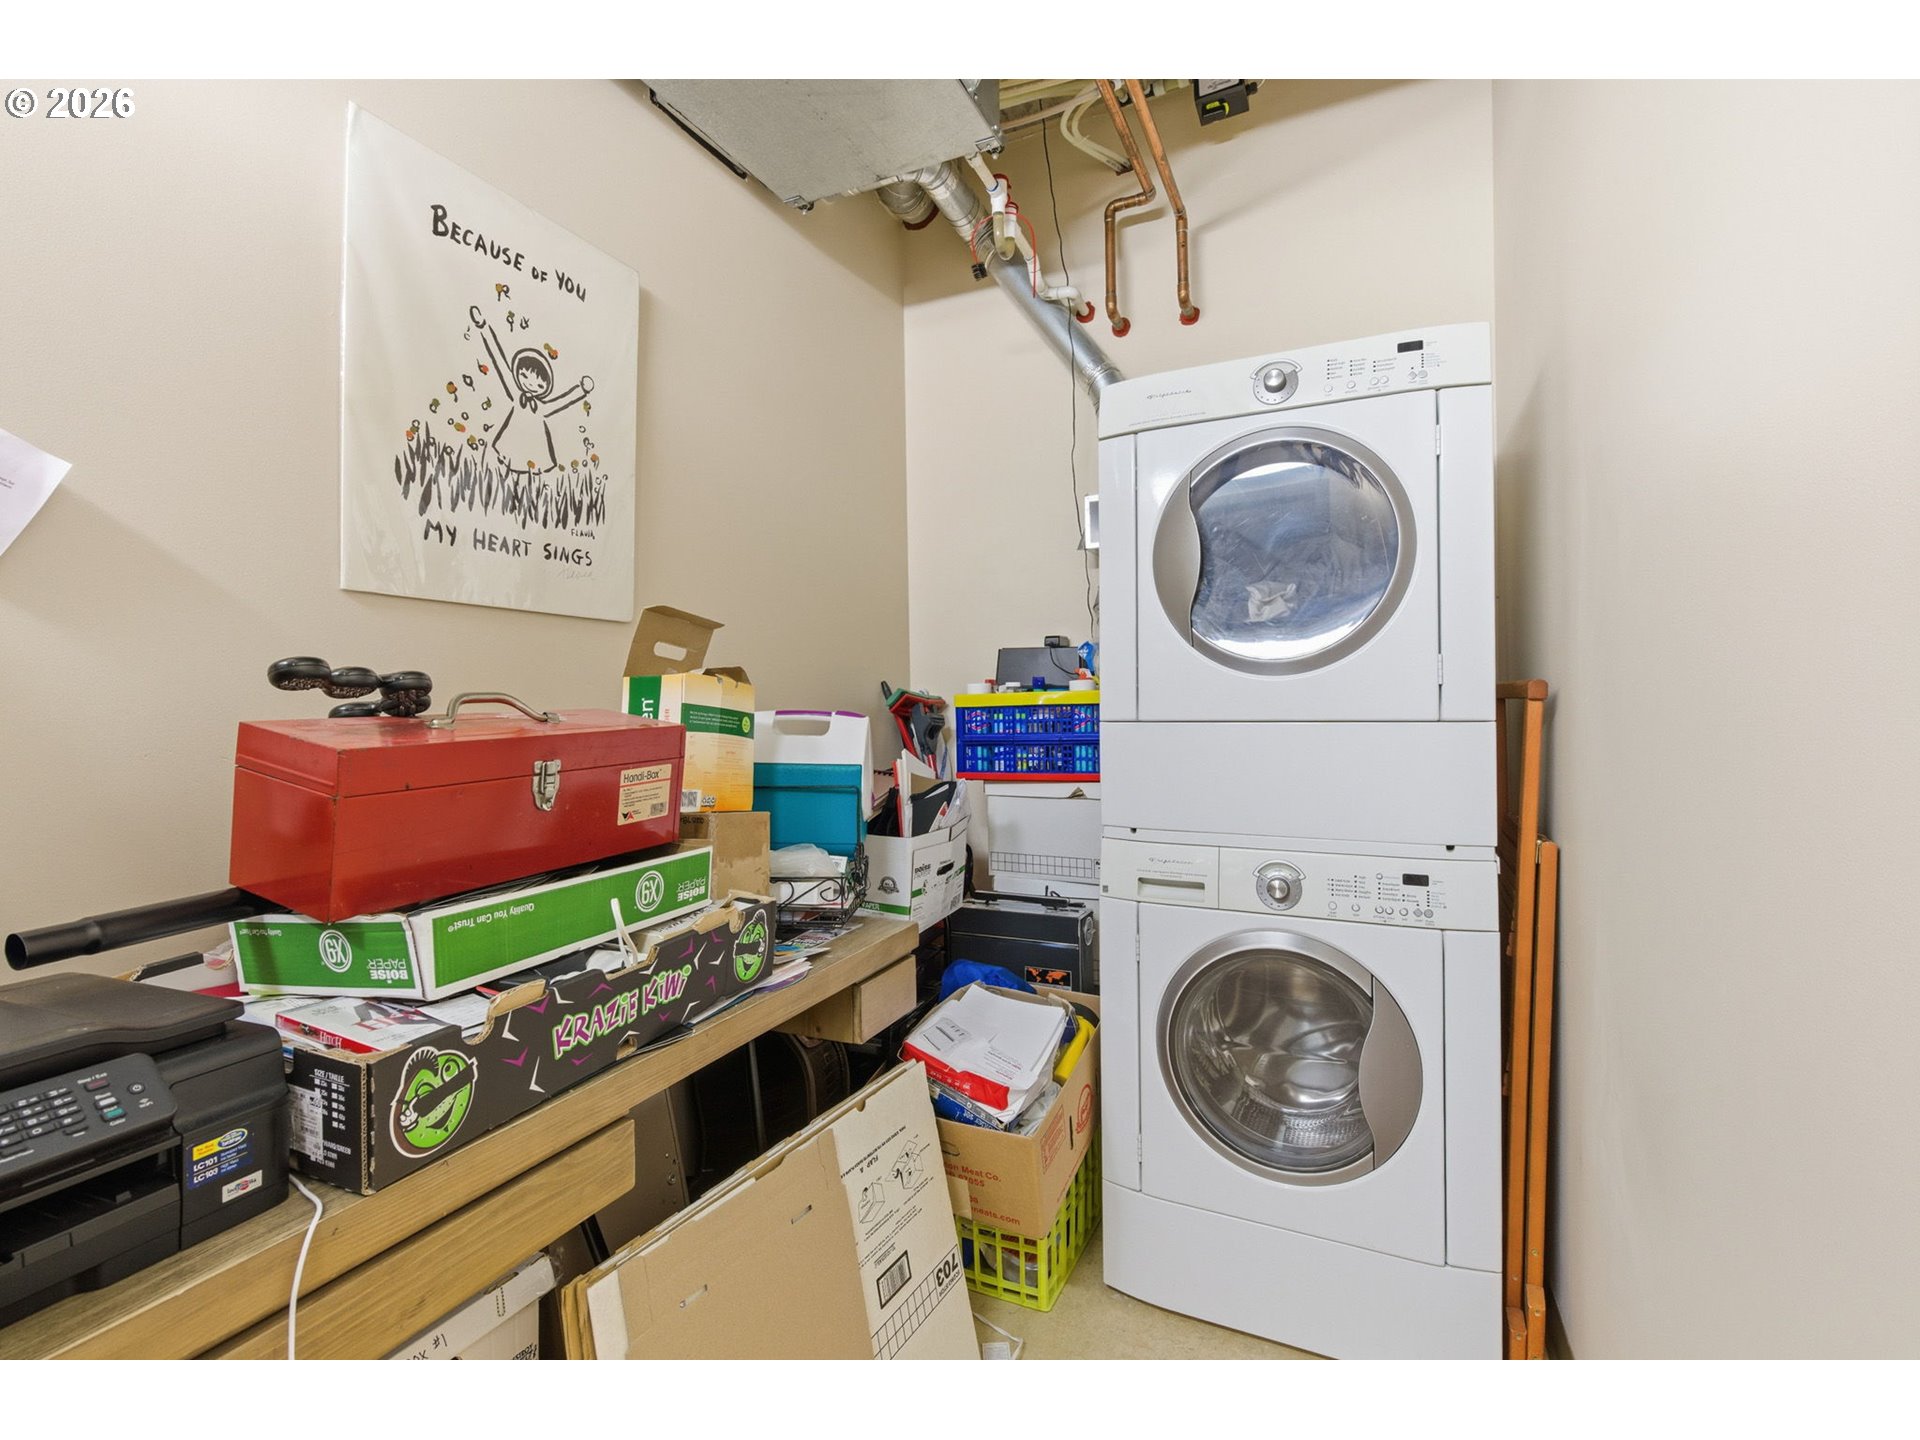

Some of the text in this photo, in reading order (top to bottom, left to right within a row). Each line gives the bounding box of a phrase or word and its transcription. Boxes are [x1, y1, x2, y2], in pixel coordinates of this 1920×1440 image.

[431, 204, 587, 302] BECAUSE OF YOU
[424, 519, 593, 567] MY HEART SINGS
[493, 908, 509, 919] You
[509, 902, 535, 916] Quality
[476, 912, 492, 924] Can
[367, 958, 407, 970] PAPER
[193, 1156, 218, 1172] LC101
[193, 1167, 219, 1183] LC103
[936, 1252, 959, 1288] 703
[432, 1333, 448, 1349] #1
